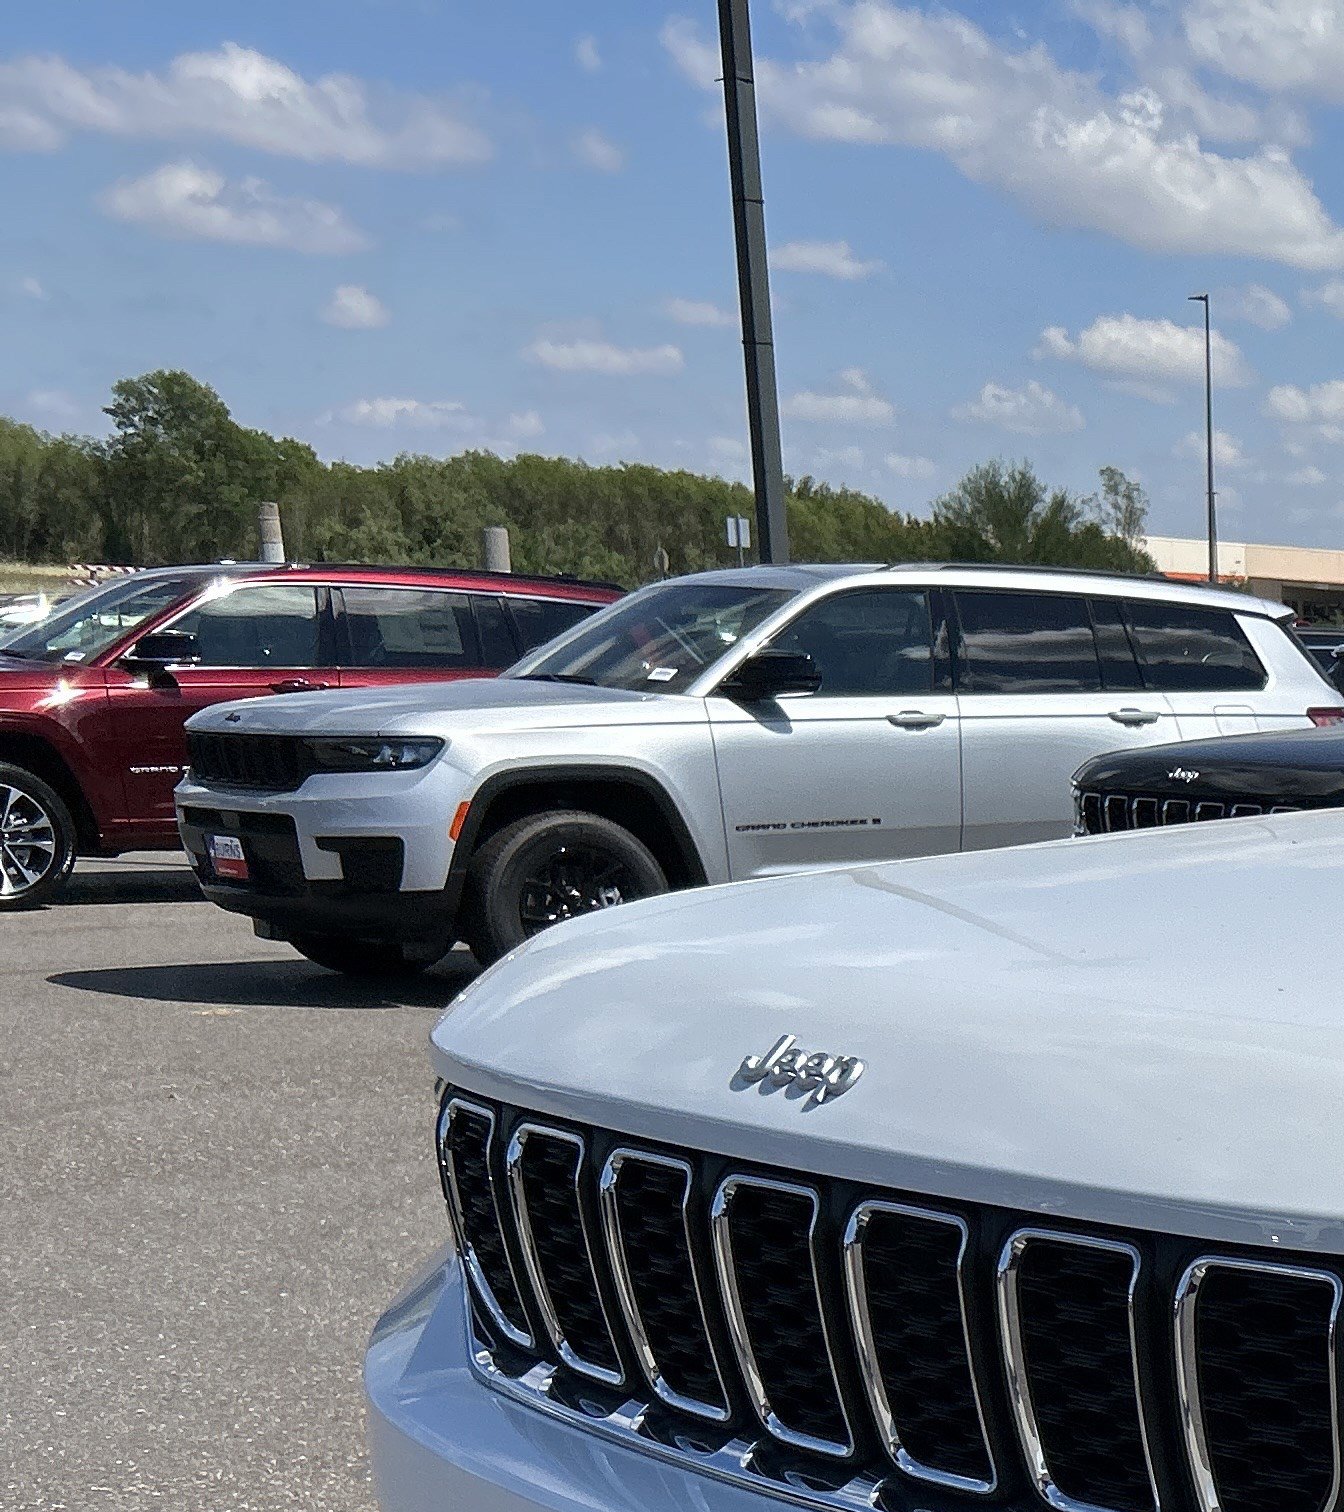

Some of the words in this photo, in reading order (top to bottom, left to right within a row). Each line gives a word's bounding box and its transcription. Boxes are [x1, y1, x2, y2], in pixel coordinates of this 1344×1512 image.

[735, 823, 787, 832] GRAND
[791, 818, 868, 829] CHEROKEE
[738, 1034, 866, 1104] Jeep
